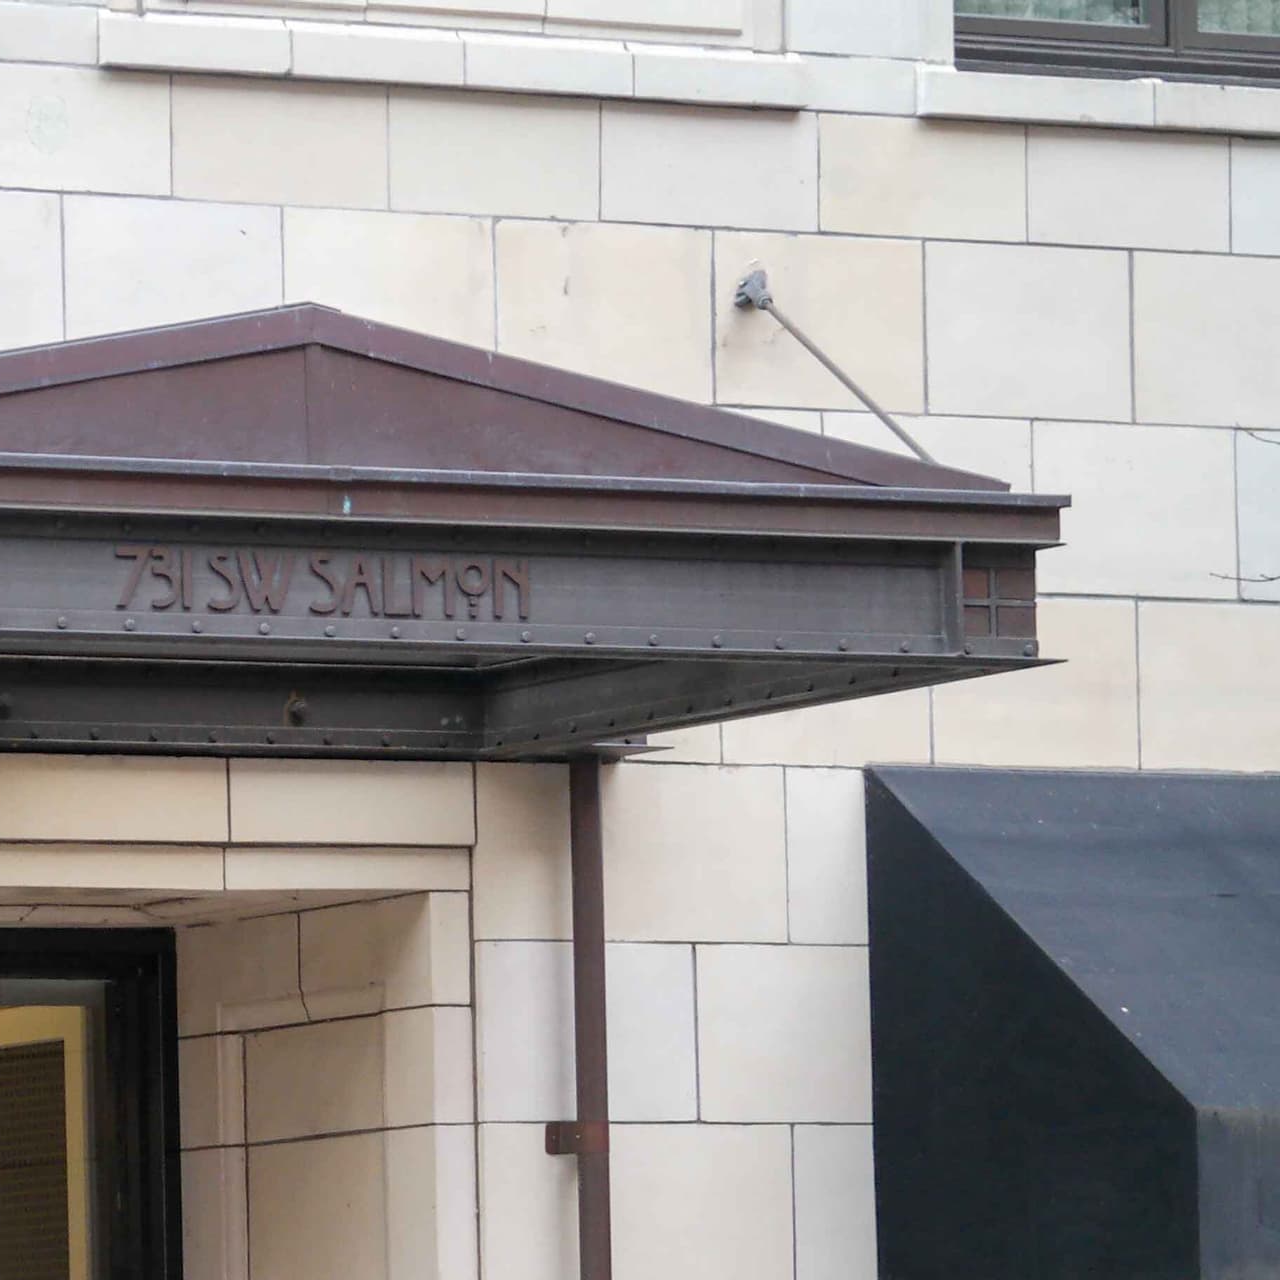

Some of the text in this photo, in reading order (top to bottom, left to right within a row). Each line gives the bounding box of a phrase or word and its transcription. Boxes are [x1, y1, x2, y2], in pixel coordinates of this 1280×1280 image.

[115, 545, 531, 621] 731 SW SALMON
